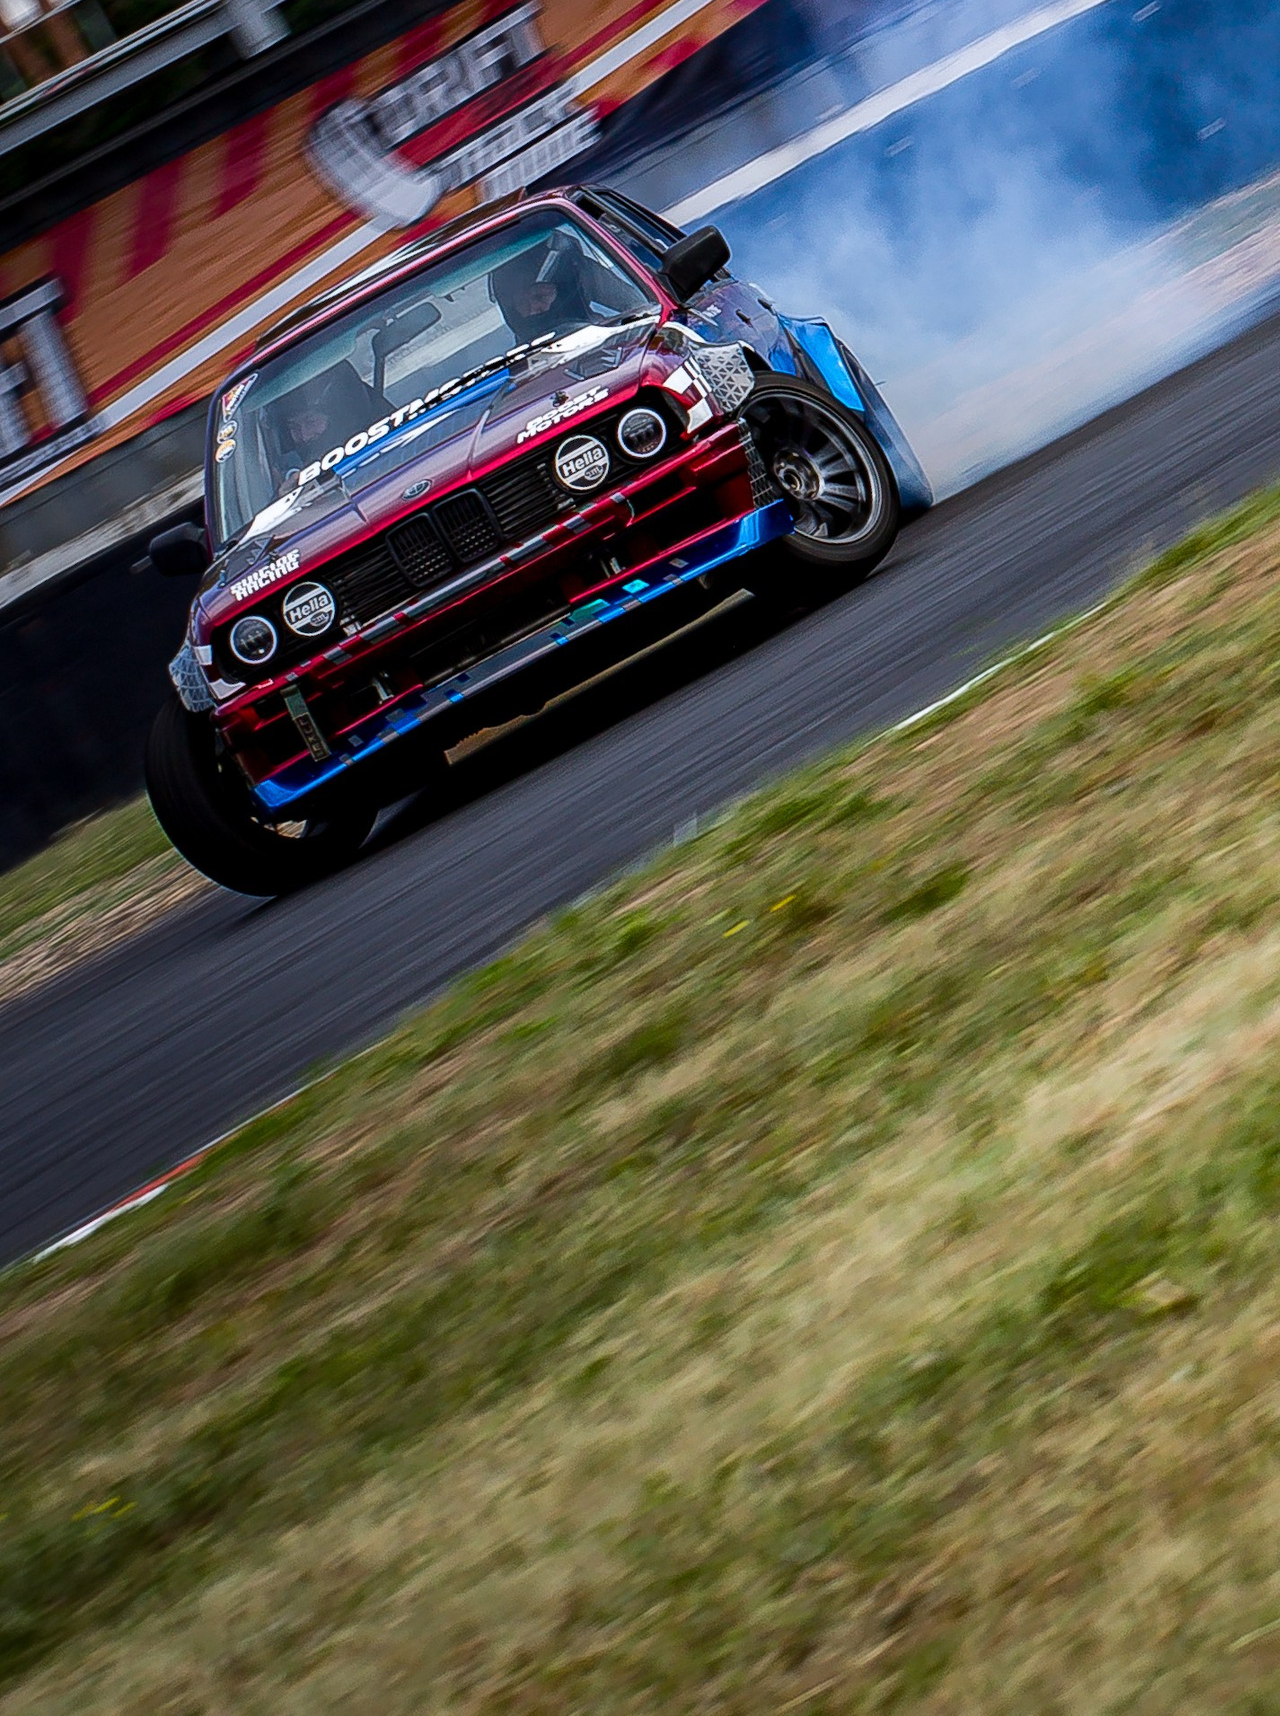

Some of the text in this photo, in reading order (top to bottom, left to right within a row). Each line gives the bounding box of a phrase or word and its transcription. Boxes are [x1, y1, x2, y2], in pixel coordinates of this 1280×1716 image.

[516, 387, 610, 445] MOTORS
[562, 448, 603, 477] Hella
[236, 561, 301, 602] RACING
[289, 594, 330, 624] Hella
